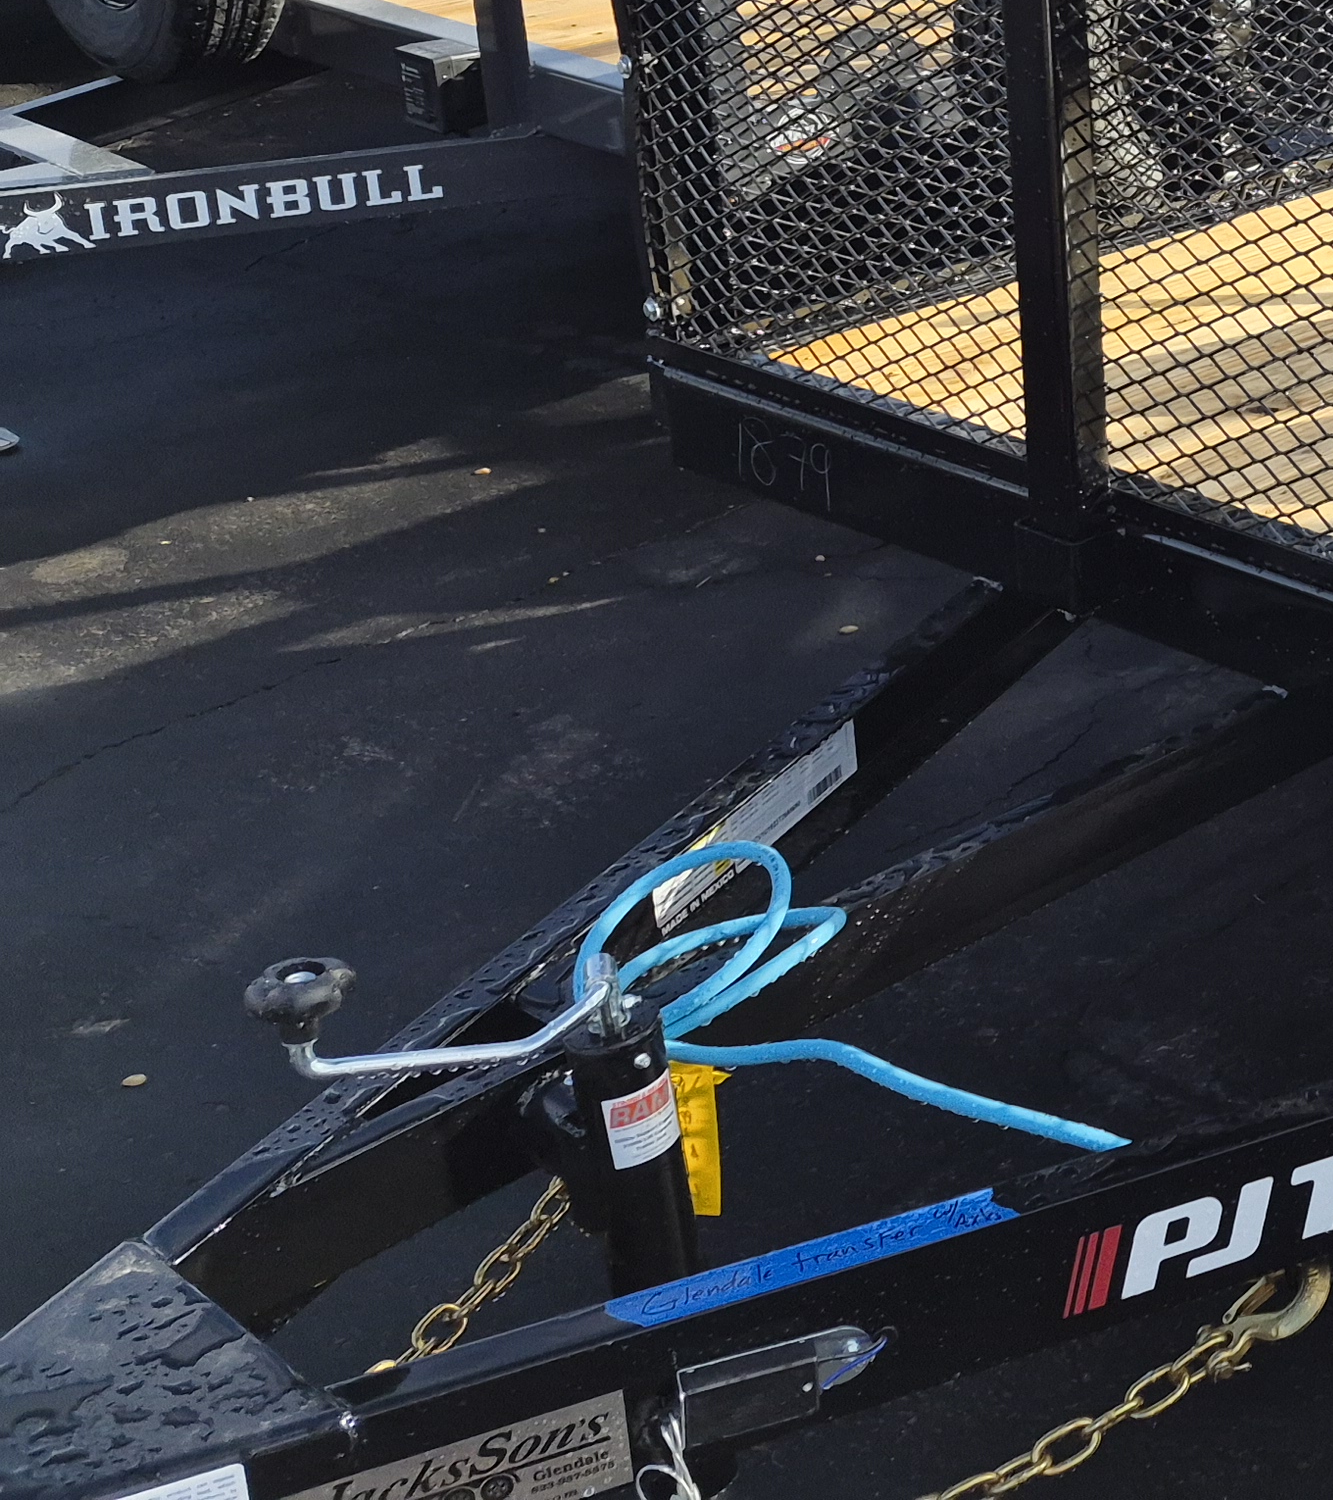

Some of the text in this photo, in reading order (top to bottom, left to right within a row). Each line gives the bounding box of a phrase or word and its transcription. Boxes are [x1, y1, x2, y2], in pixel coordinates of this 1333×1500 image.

[84, 164, 444, 241] IRONBULL
[738, 416, 832, 512] 1879
[660, 870, 736, 937] MADE IN MEXICO
[1120, 1176, 1274, 1300] PJ
[641, 1264, 773, 1316] Glendale
[532, 1449, 609, 1481] Glendale
